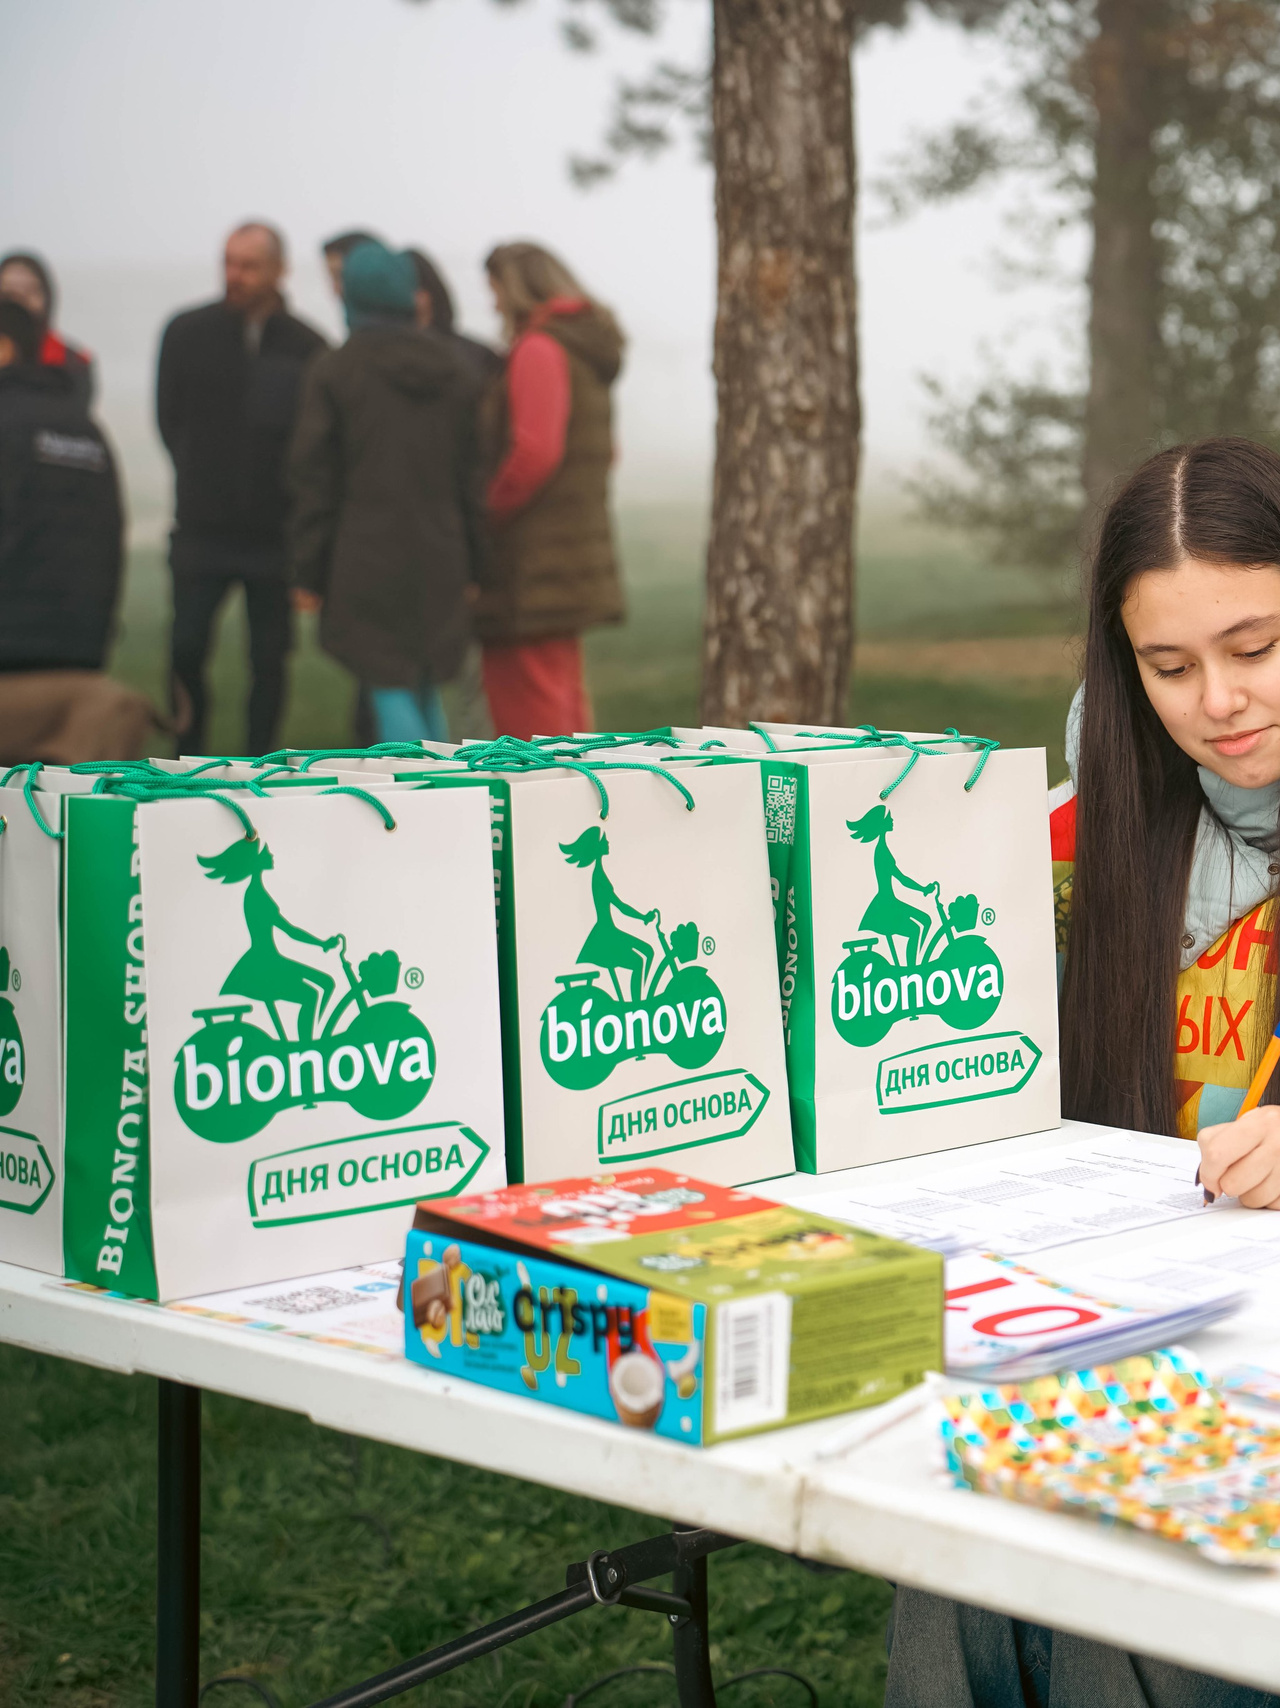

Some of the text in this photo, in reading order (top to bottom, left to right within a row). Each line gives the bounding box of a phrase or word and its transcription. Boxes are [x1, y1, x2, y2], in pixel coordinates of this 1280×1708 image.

[837, 962, 1002, 1021] bionova
[547, 995, 725, 1062] bionova
[183, 1035, 433, 1112] bionova
[885, 1049, 1026, 1098] ДНЯ ОСНОВА
[607, 1088, 752, 1146] ДНЯ ОСНОВА
[261, 1143, 466, 1206] ДНЯ ОСНОВА
